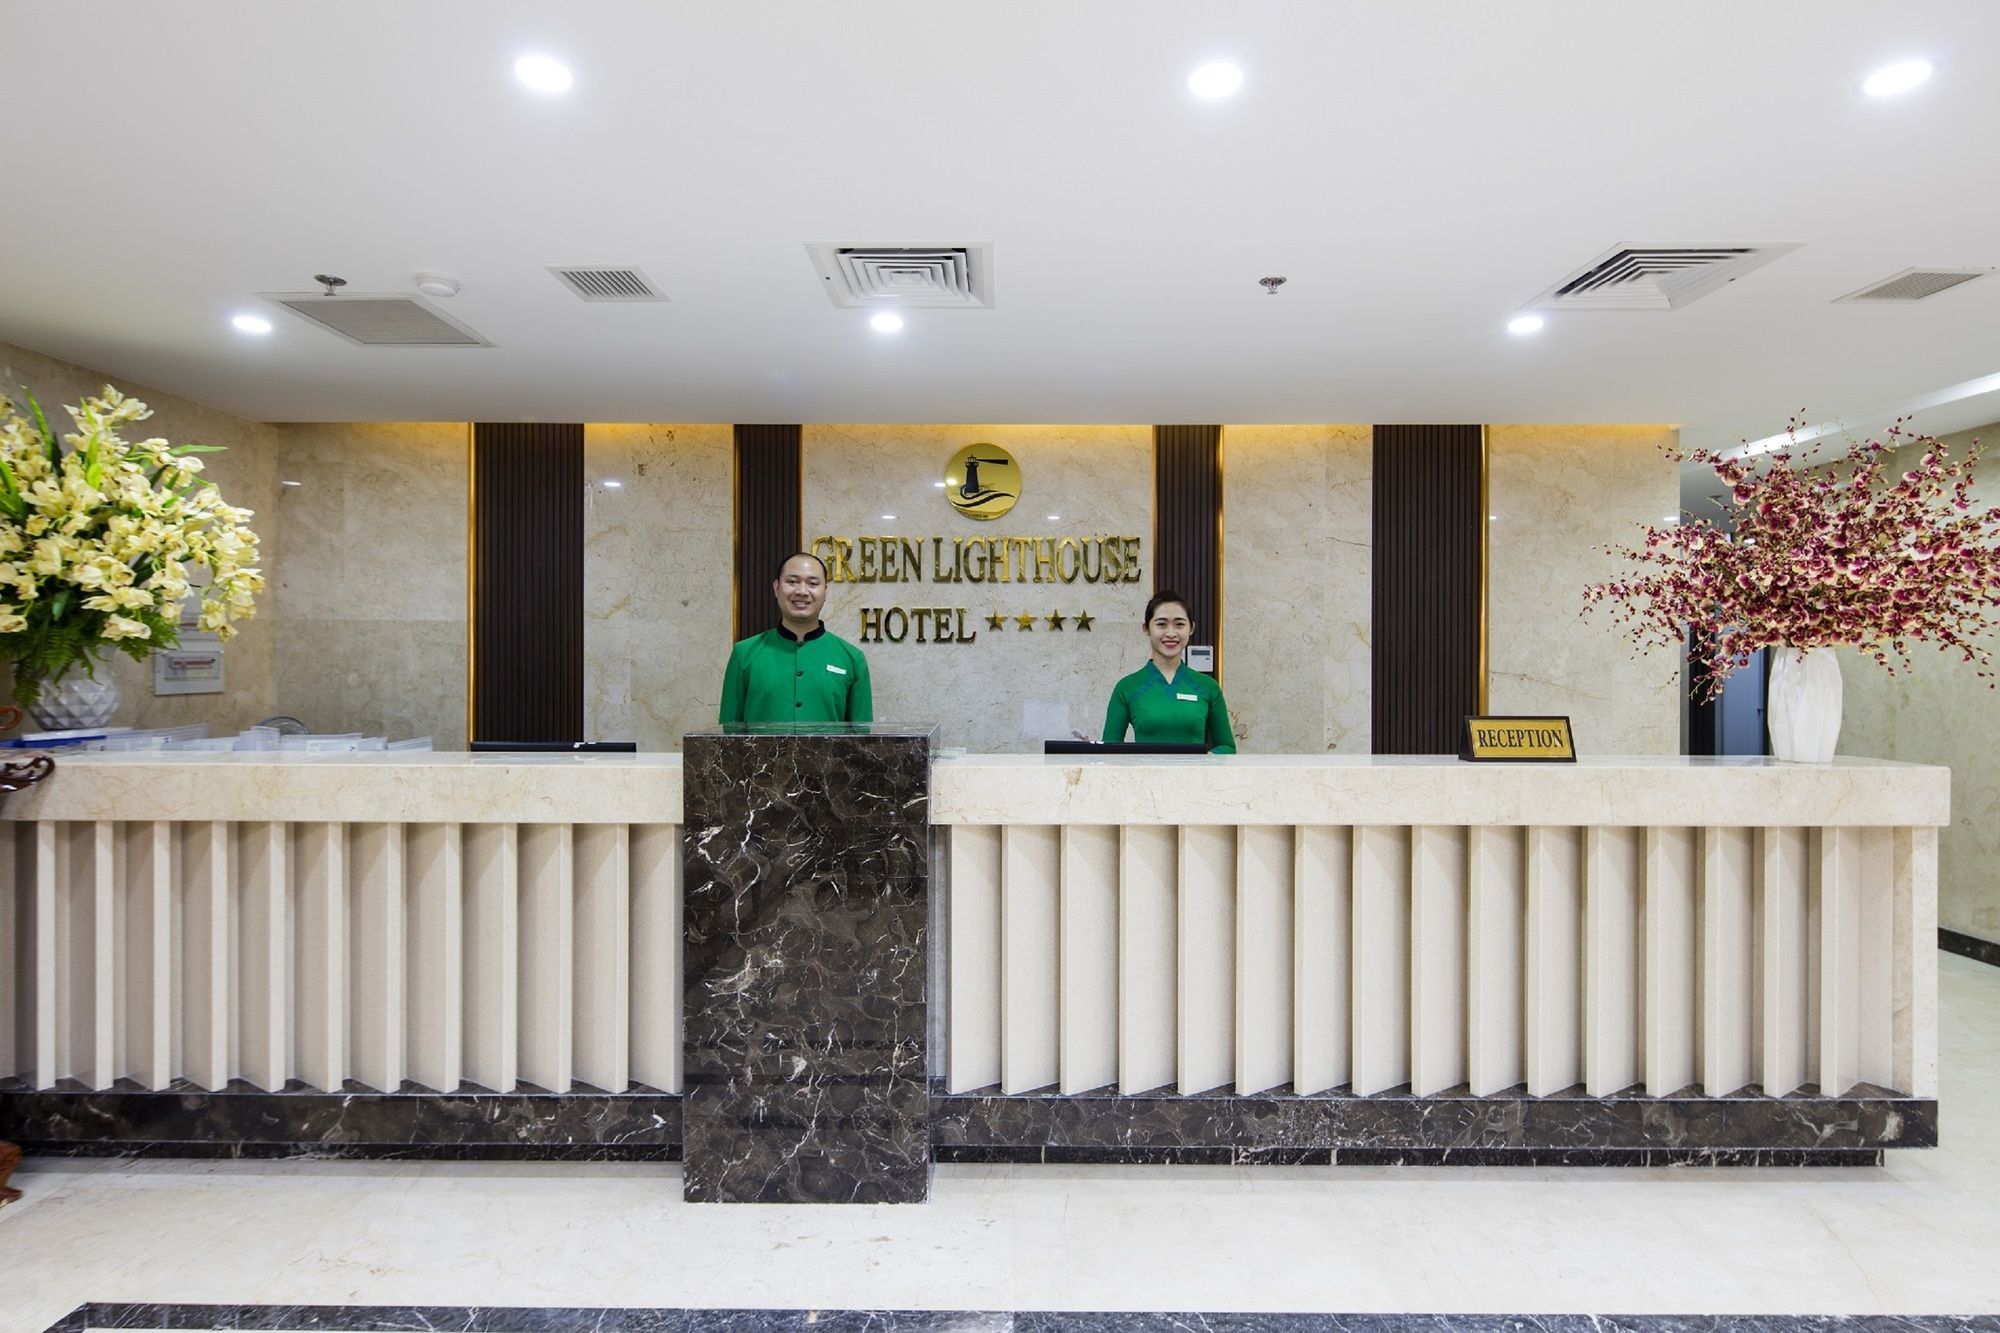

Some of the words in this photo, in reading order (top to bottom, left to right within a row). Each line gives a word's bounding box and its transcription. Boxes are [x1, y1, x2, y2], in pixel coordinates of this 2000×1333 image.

[811, 535, 925, 582] GREEN
[932, 535, 1142, 584] LIGHTHOUSE
[859, 606, 977, 643] HOTEL
[1477, 729, 1564, 748] RECEPTION
